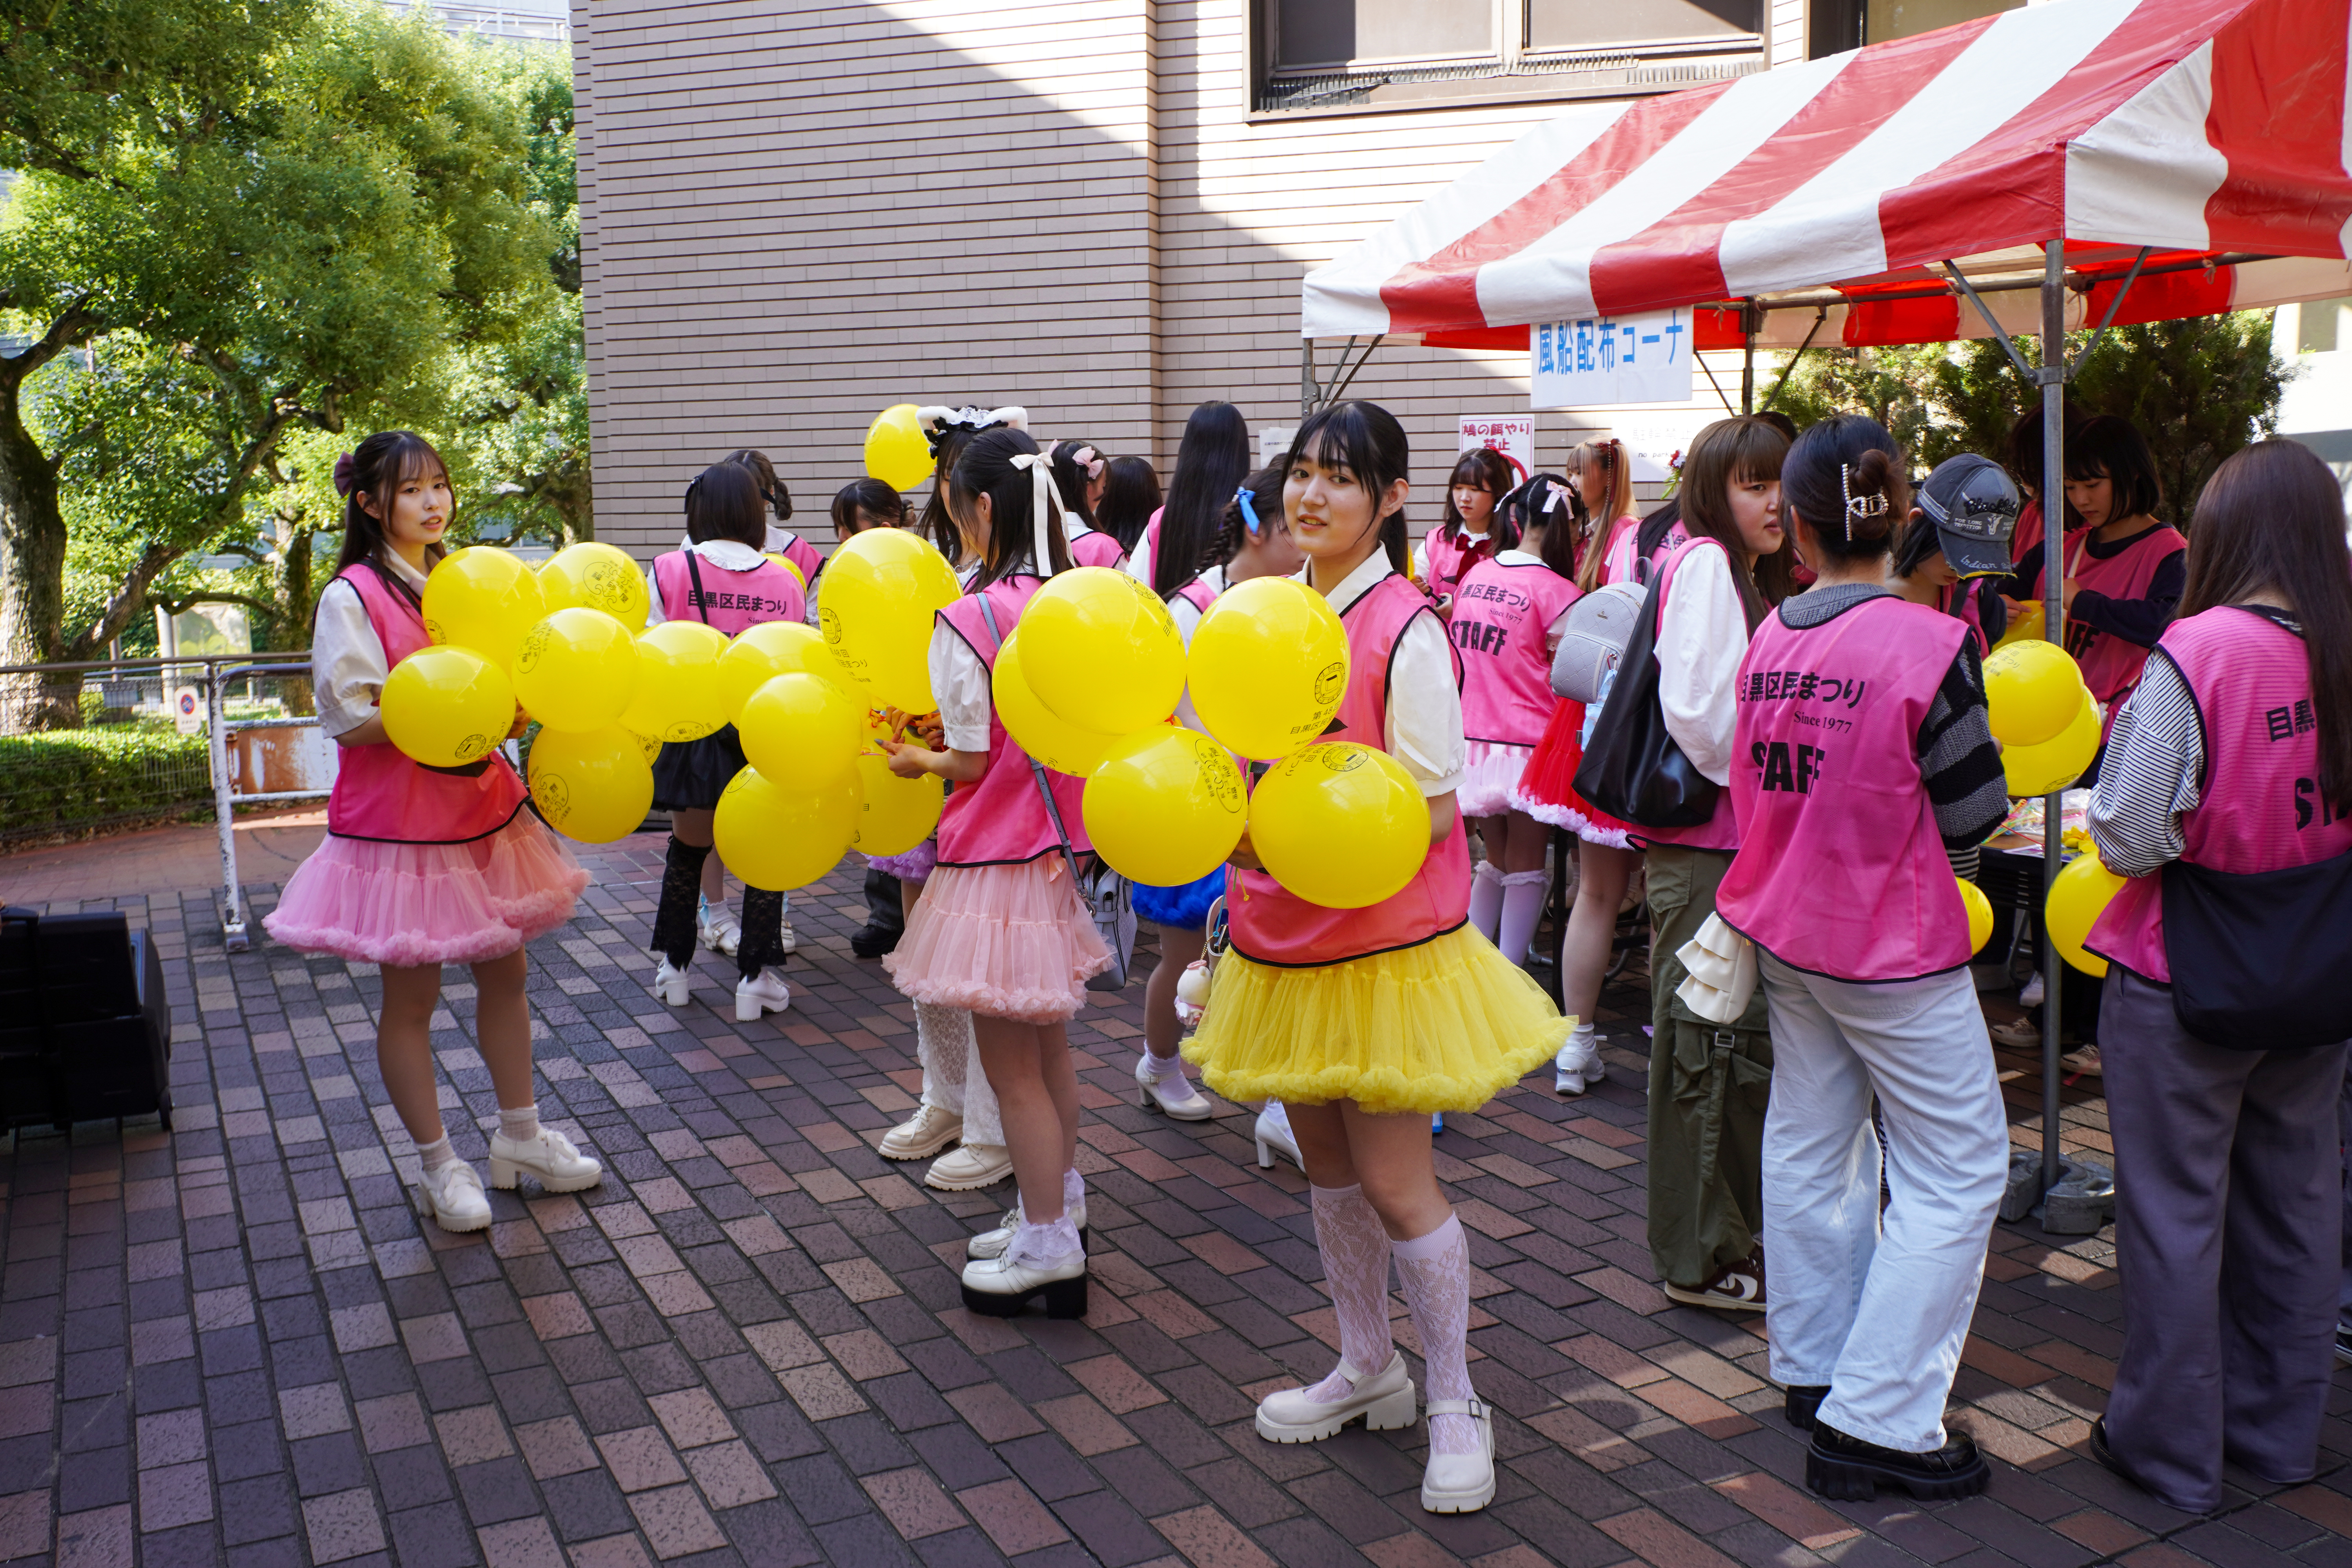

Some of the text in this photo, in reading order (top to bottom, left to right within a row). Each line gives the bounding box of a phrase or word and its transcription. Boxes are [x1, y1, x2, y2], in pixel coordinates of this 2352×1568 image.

[1539, 310, 1683, 376] 風船配布コーナ
[1464, 423, 1529, 436] 鳩の餌やり
[1633, 427, 1693, 441] 駐輪禁止
[1488, 608, 1522, 625] Since 1977
[1451, 620, 1508, 657] STAFF
[1794, 710, 1852, 734] Since 1977
